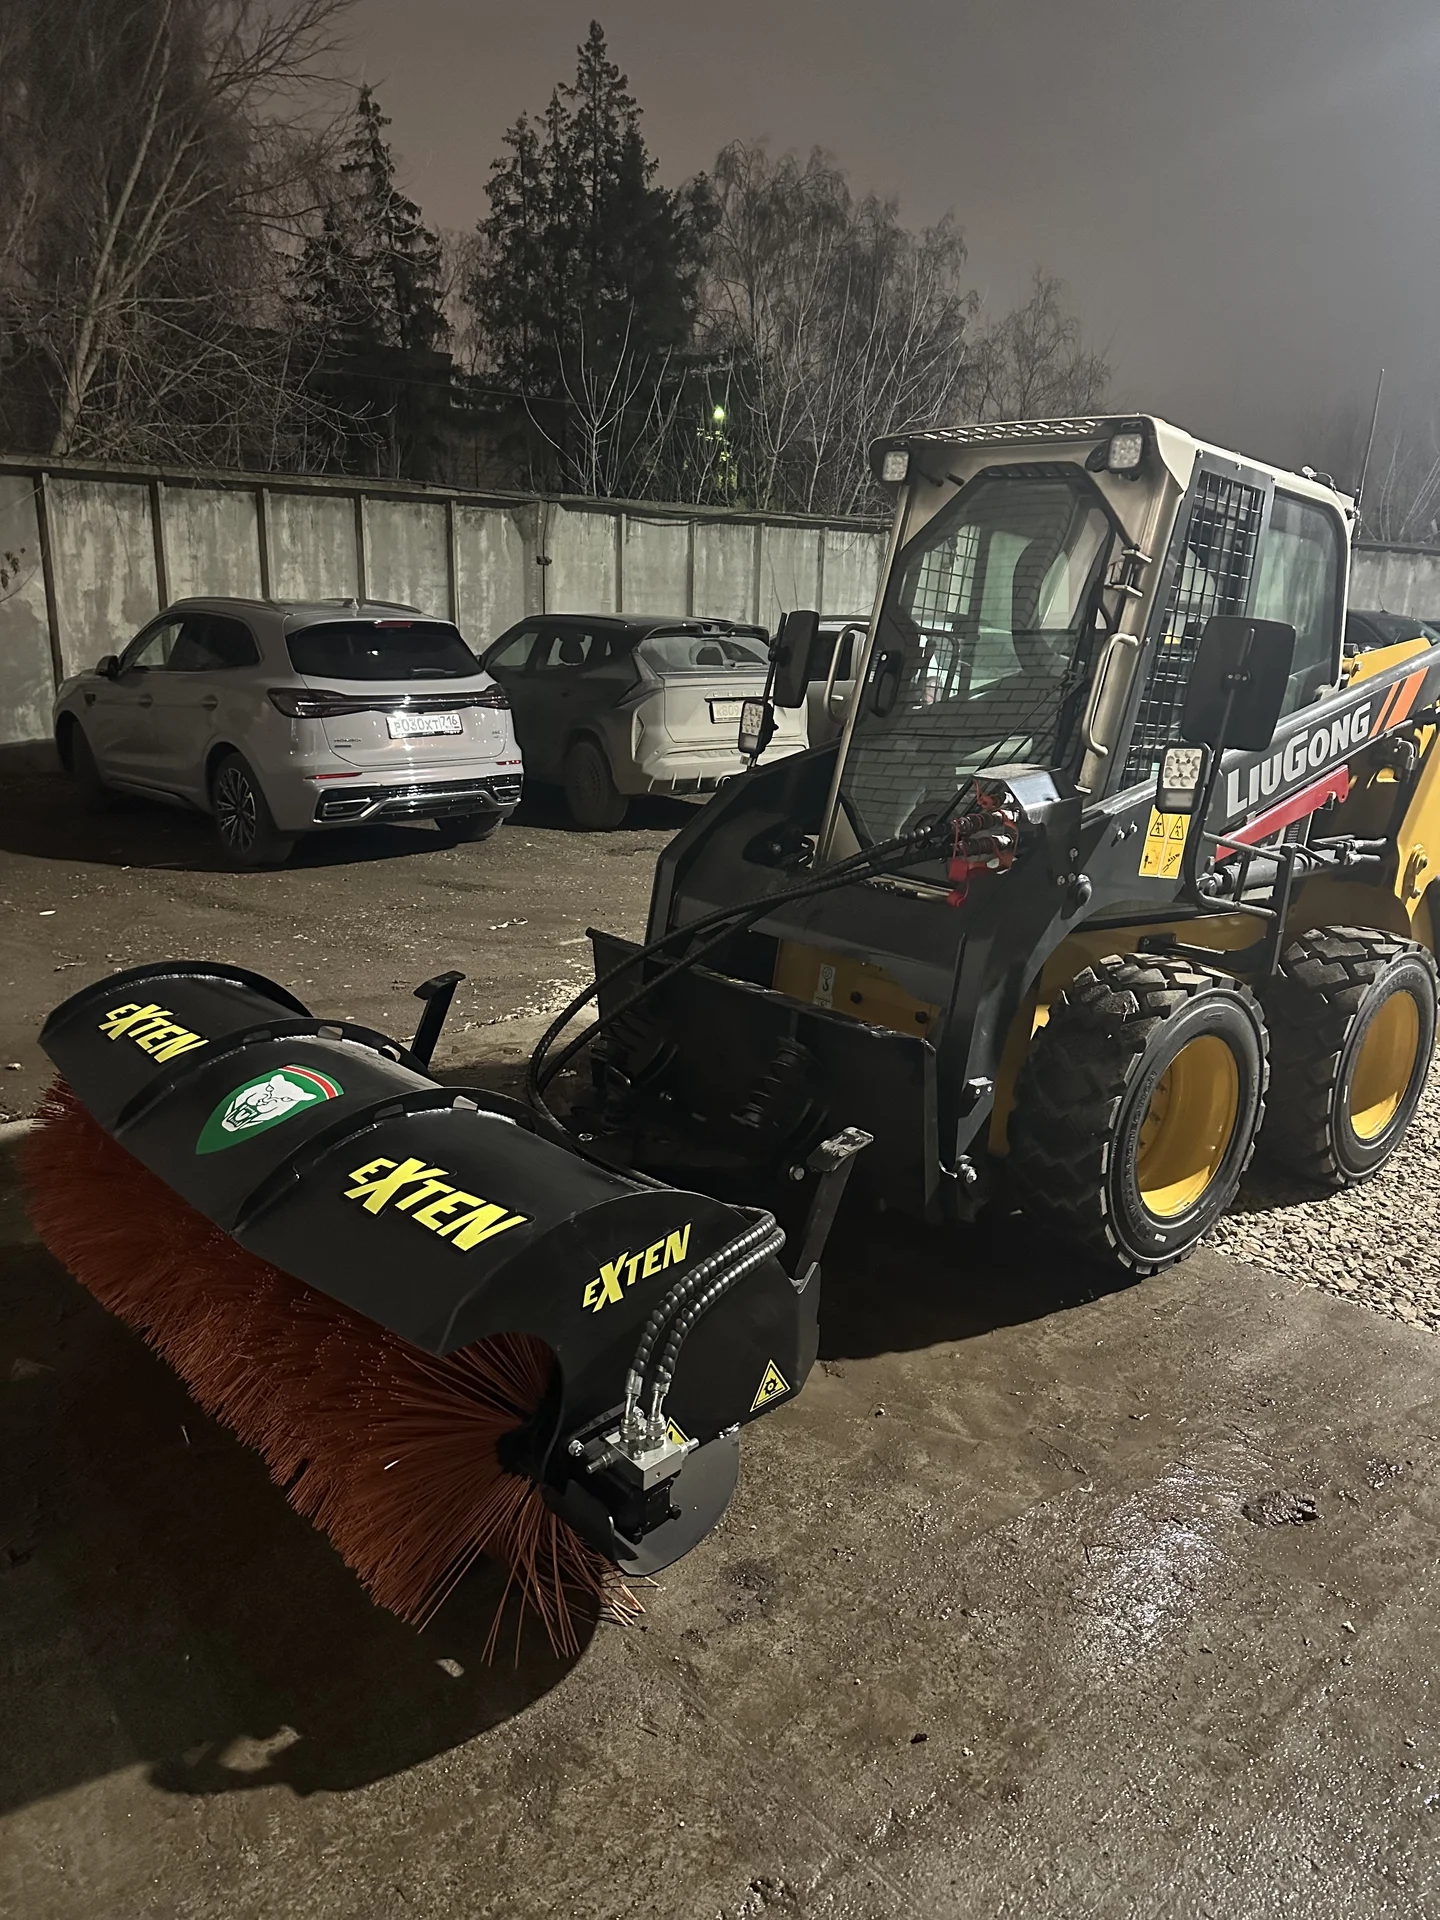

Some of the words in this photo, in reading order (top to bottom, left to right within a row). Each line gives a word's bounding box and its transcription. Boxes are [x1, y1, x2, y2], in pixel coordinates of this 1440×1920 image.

[440, 716, 459, 726] 716
[98, 1003, 209, 1063] EXTEN
[344, 1157, 527, 1251] EXTEN
[582, 1223, 691, 1313] EXTEN
